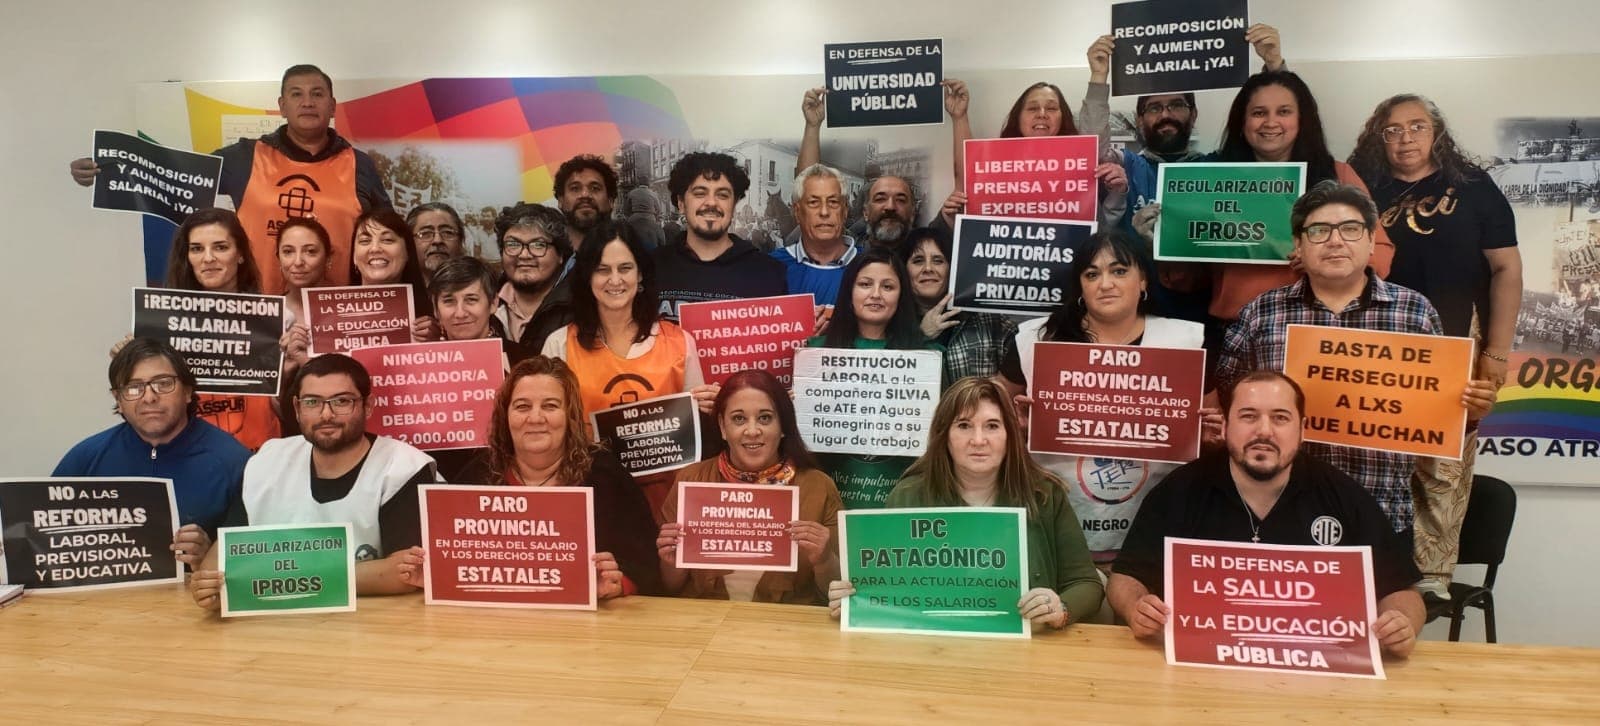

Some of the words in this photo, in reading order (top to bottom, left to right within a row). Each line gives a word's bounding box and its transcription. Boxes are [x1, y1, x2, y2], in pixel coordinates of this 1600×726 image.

[1115, 16, 1244, 39] RECOMPOSICIÓN
[830, 50, 845, 60] EN
[849, 48, 903, 59] DEFENSA
[906, 46, 922, 56] DE
[926, 45, 941, 55] LA
[1134, 45, 1146, 56] Y
[1149, 38, 1225, 55] AUMENTO
[1125, 59, 1200, 76] SALARIAL
[1204, 56, 1234, 72] ¡YA!
[832, 72, 936, 91] UNIVERSIDAD
[851, 92, 918, 111] PÚBLICA
[98, 148, 214, 188] RECOMPOSICIÓN
[974, 159, 1059, 174] LIBERTAD
[1064, 158, 1088, 171] DE
[117, 163, 127, 174] Y
[130, 168, 194, 200] AUMENTO
[974, 181, 1043, 194] PRENSA
[1048, 180, 1060, 192] Y
[1065, 179, 1088, 192] DE
[1167, 177, 1295, 194] REGULARIZACIÓN
[109, 180, 172, 206] SALARIAL
[981, 199, 1080, 215] EXPRESIÓN
[1214, 200, 1241, 213] DEL
[989, 224, 1010, 238] NO
[1012, 226, 1023, 239] A
[1026, 226, 1056, 241] LAS
[1188, 221, 1266, 240] IPROSS
[972, 242, 1074, 263] AUDITORÍAS
[987, 263, 1051, 281] MÉDICAS
[335, 291, 381, 300] DEFENSA
[383, 290, 396, 298] DE
[975, 283, 1062, 302] PRIVADAS
[144, 294, 279, 317] ¡RECOMPOSICIÓN
[320, 306, 334, 314] LA
[336, 301, 384, 314] SALUD
[711, 304, 783, 321] NINGÚN/A
[168, 316, 251, 335] SALARIAL
[337, 317, 409, 331] EDUCACIÓN
[692, 321, 804, 341] TRABAJADOR/A
[170, 337, 251, 355] URGENTE!
[334, 335, 390, 350] PÚBLICA
[720, 342, 777, 356] SALARIO
[382, 350, 464, 366] NINGÚN/A
[1089, 349, 1141, 367] PARO
[1320, 340, 1393, 361] BASTA
[1402, 347, 1432, 364] DE
[186, 357, 220, 367] CORDE
[223, 359, 235, 368] AL
[711, 361, 768, 374] DEBAJO
[772, 358, 791, 369] DE
[821, 354, 917, 369] RESTITUCIÓN
[213, 366, 278, 378] PATAGÓNICO
[821, 372, 888, 385] LABORAL
[890, 376, 900, 385] a
[903, 374, 915, 385] la
[1307, 365, 1440, 391] PERSEGUIR
[1060, 371, 1172, 392] PROVINCIAL
[393, 392, 458, 406] SALARIO
[463, 389, 496, 401] POR
[805, 388, 882, 400] compañera
[885, 388, 931, 401] SILVIA
[1038, 391, 1053, 400] EN
[1057, 392, 1110, 402] DEFENSA
[1114, 394, 1135, 404] DEL
[1139, 396, 1190, 408] SALARIO
[814, 402, 831, 413] de
[834, 403, 857, 414] ATE
[860, 406, 876, 415] en
[879, 405, 921, 417] Aguas
[1044, 402, 1050, 410] Y
[1054, 403, 1075, 412] LOS
[1079, 404, 1141, 416] DERECHOS
[1145, 407, 1161, 417] DE
[1164, 409, 1187, 419] LXS
[1335, 394, 1350, 409] A
[1359, 396, 1402, 414] LXS
[383, 411, 447, 427] DEBAJO
[453, 410, 474, 422] DE
[623, 409, 638, 419] NO
[616, 417, 680, 437] REFORMAS
[812, 417, 891, 432] Rionegrinas
[894, 422, 903, 431] a
[906, 423, 921, 432] su
[1059, 418, 1169, 441] ESTATALES
[1347, 421, 1445, 445] LUCHAN
[627, 436, 674, 448] LABORAL,
[813, 433, 847, 446] lugar
[850, 434, 867, 446] de
[870, 436, 920, 449] trabajo
[1545, 439, 1600, 457] ATR
[620, 444, 683, 460] PREVISIONAL
[631, 454, 683, 468] EDUCATIVA
[48, 486, 74, 500] NO
[79, 490, 89, 499] A
[93, 489, 119, 498] LAS
[721, 491, 753, 503] PARO
[479, 495, 528, 513] PARO
[702, 506, 774, 519] PROVINCIAL
[33, 507, 147, 528] REFORMAS
[1083, 519, 1129, 531] NEGRO
[454, 519, 560, 536] PROVINCIAL
[911, 519, 947, 539] IPC
[1313, 518, 1341, 545] ATE
[50, 533, 135, 548] LABORAL,
[230, 537, 342, 555] REGULARIZACIÓN
[436, 539, 450, 548] EN
[453, 540, 503, 549] DEFENSA
[506, 541, 527, 550] DEL
[530, 542, 578, 551] SALARIO
[702, 539, 772, 552] ESTATALES
[36, 547, 152, 565] PREVISIONAL
[442, 551, 449, 559] Y
[452, 551, 472, 560] LOS
[475, 552, 535, 561] DERECHOS
[538, 553, 552, 561] DE
[556, 553, 575, 562] LXS
[861, 544, 1006, 569] PATAGÓNICO
[1191, 555, 1215, 568] EN
[1221, 556, 1309, 573] DEFENSA
[1314, 561, 1340, 574] DE
[36, 570, 47, 581] Y
[52, 562, 152, 581] EDUCATIVA
[274, 560, 298, 571] DEL
[458, 566, 561, 584] ESTATALES
[851, 576, 886, 587] PARA
[891, 577, 906, 587] LA
[910, 576, 1018, 589] ACTUALIZACIÓN
[253, 576, 322, 596] IPROSS
[1193, 580, 1217, 594] LA
[1223, 578, 1315, 599] SALUD
[870, 596, 888, 606] DE
[894, 597, 920, 607] LOS
[925, 597, 997, 609] SALARIOS
[1179, 615, 1190, 627] Y
[1195, 616, 1216, 629] LA
[1223, 614, 1366, 637] EDUCACIÓN
[1216, 642, 1329, 668] PÚBLICA
